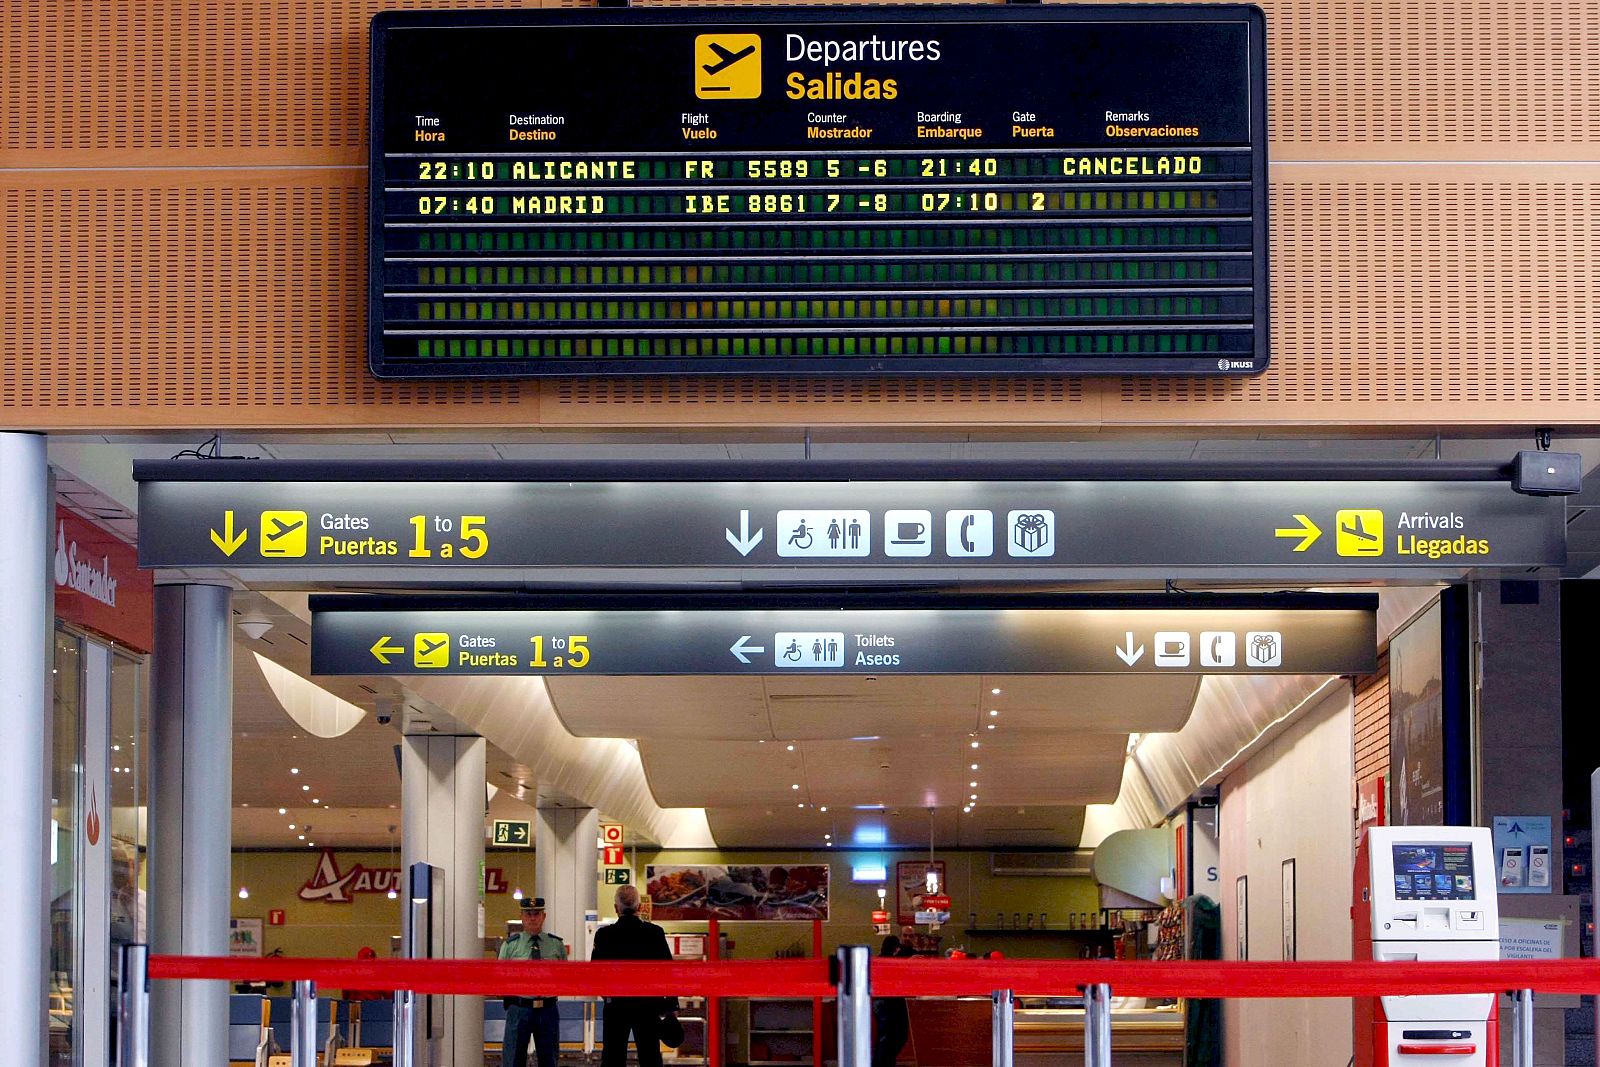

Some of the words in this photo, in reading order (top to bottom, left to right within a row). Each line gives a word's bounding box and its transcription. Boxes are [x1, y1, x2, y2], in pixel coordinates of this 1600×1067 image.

[786, 33, 941, 67] Departures
[785, 71, 898, 100] Salidas
[415, 115, 440, 127] Time
[509, 114, 565, 126] Destination
[681, 113, 709, 126] Flight
[807, 112, 847, 123] Counter
[917, 111, 962, 124] Boarding
[1012, 111, 1036, 122] Gate
[1105, 110, 1150, 122] Remarks
[415, 129, 445, 142] Hora
[509, 128, 557, 141] Destino
[681, 127, 718, 140] Vuelo
[807, 126, 873, 139] Mostrador
[917, 125, 983, 140] Embarque
[1012, 125, 1055, 138] Puerta
[1105, 124, 1199, 137] Observaciones
[419, 161, 494, 180] 22:10
[513, 161, 635, 180] ALICANTE
[685, 160, 714, 179] FR
[748, 159, 808, 178] 5589
[827, 159, 840, 178] 5
[921, 158, 997, 177] 21:40
[1063, 156, 1201, 176] CANCELADO
[419, 196, 494, 215] 07:40
[513, 195, 604, 214] MADRID
[685, 195, 730, 213] IBE
[748, 194, 805, 213] 8861
[827, 194, 840, 212] 7
[922, 192, 998, 211] 07:10
[1032, 192, 1045, 211] 2
[1230, 361, 1253, 369] IKUSI
[320, 512, 370, 530] Gates
[1397, 511, 1464, 529] Arrivals
[408, 514, 431, 558] 1
[433, 515, 453, 533] to
[458, 515, 489, 559] 5
[320, 535, 398, 556] Puertas
[440, 543, 453, 558] a
[1397, 534, 1489, 559] Llegadas
[68, 540, 117, 608] Santander
[458, 631, 496, 648] Gates
[854, 633, 896, 648] Toilets
[529, 632, 547, 667] 1
[551, 635, 566, 650] to
[567, 635, 590, 668] 5
[459, 651, 518, 666] Puertas
[553, 656, 563, 668] a
[855, 651, 901, 666] Aseos
